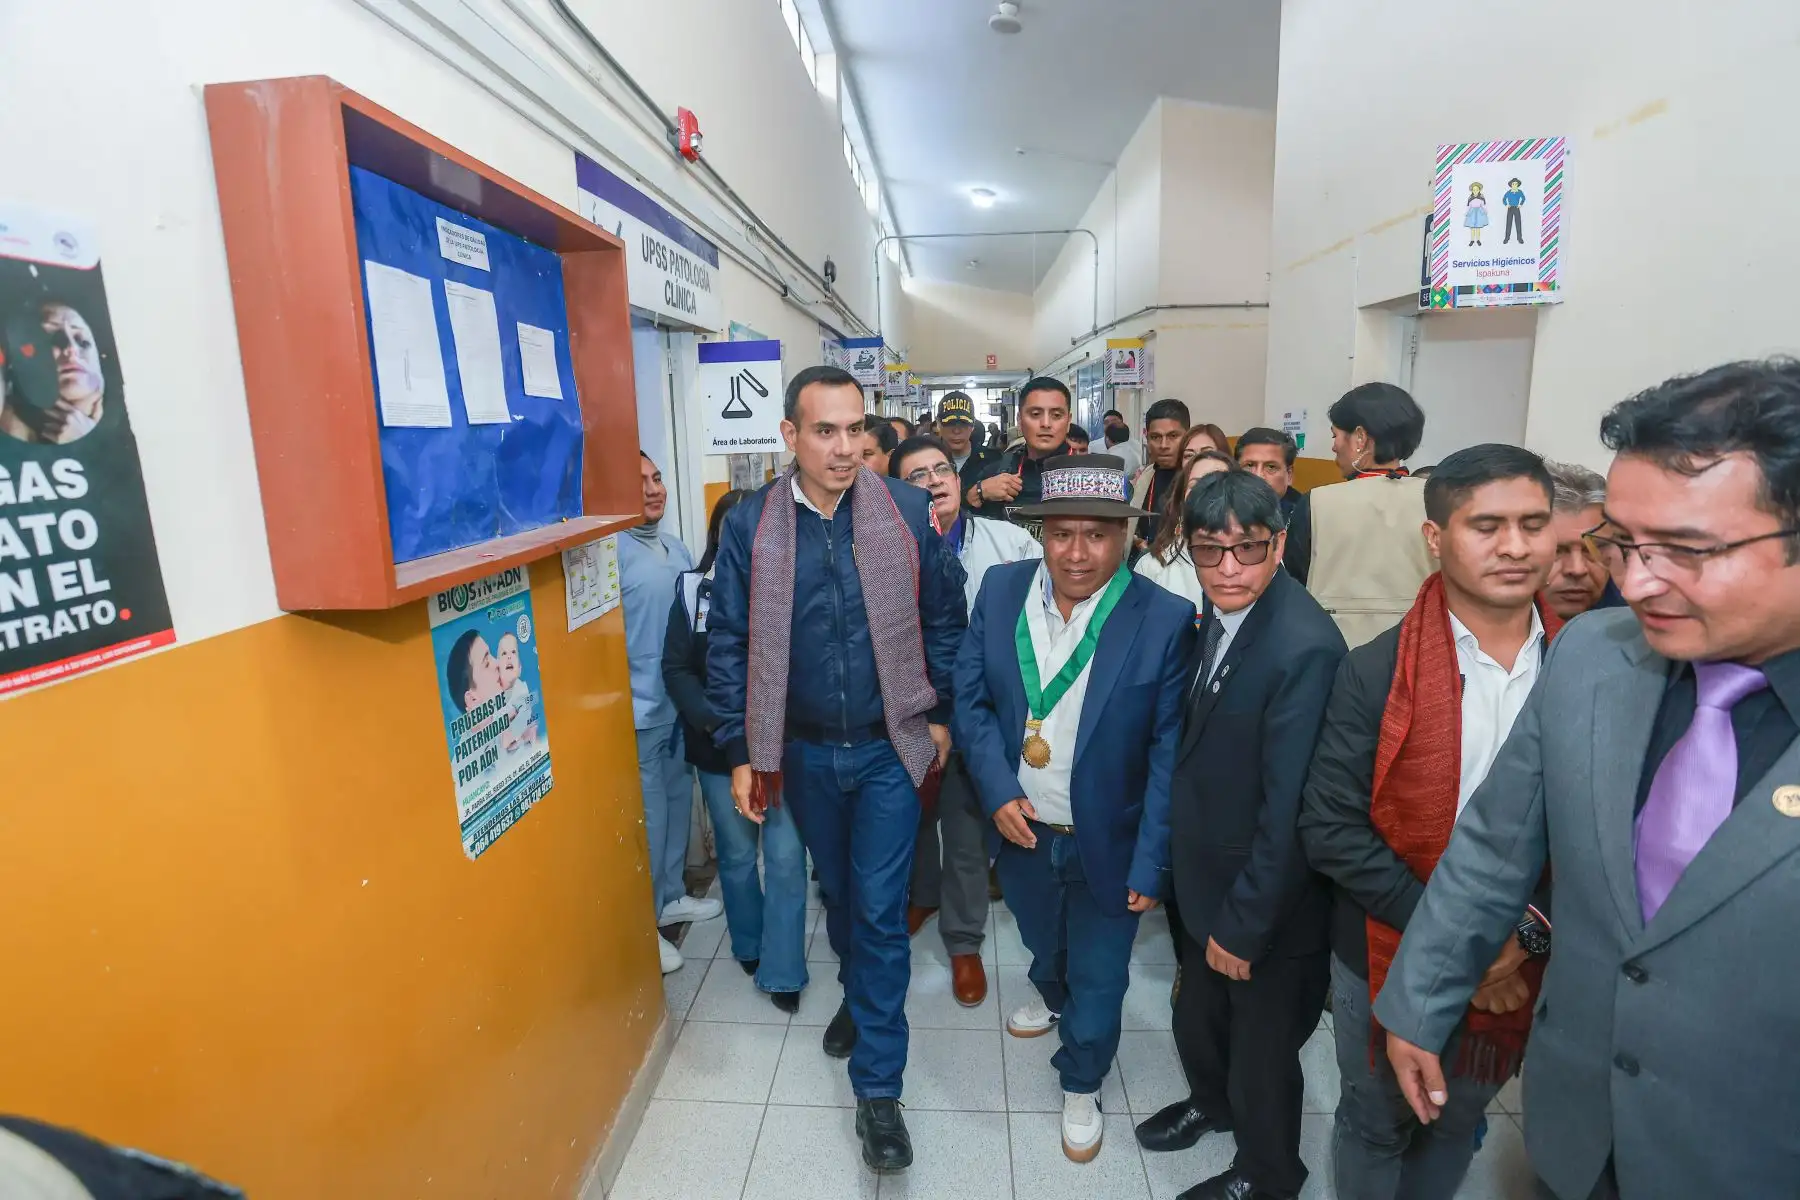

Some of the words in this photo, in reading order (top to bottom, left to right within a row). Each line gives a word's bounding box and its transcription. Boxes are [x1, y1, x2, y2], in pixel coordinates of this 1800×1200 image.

[641, 233, 667, 272] UPSS
[669, 248, 711, 293] PATOLOGÍA
[1452, 258, 1490, 268] Servicios
[1492, 256, 1535, 268] Higiénicos
[1476, 269, 1510, 278] Ispakuna
[664, 278, 697, 315] CLÍNICA
[943, 398, 970, 413] POLICIA
[713, 436, 728, 446] Área
[729, 438, 738, 446] de
[739, 436, 777, 446] Laboratorio
[47, 558, 111, 602] EL
[0, 599, 132, 652] TRATO.
[450, 698, 494, 739] PRUEBAS
[495, 691, 507, 711] DE
[455, 713, 510, 763] PATERNIDAD
[458, 760, 479, 787] POR
[480, 744, 498, 772] ADN
[473, 805, 509, 842] ATENDEMOS
[509, 795, 520, 809] LAS
